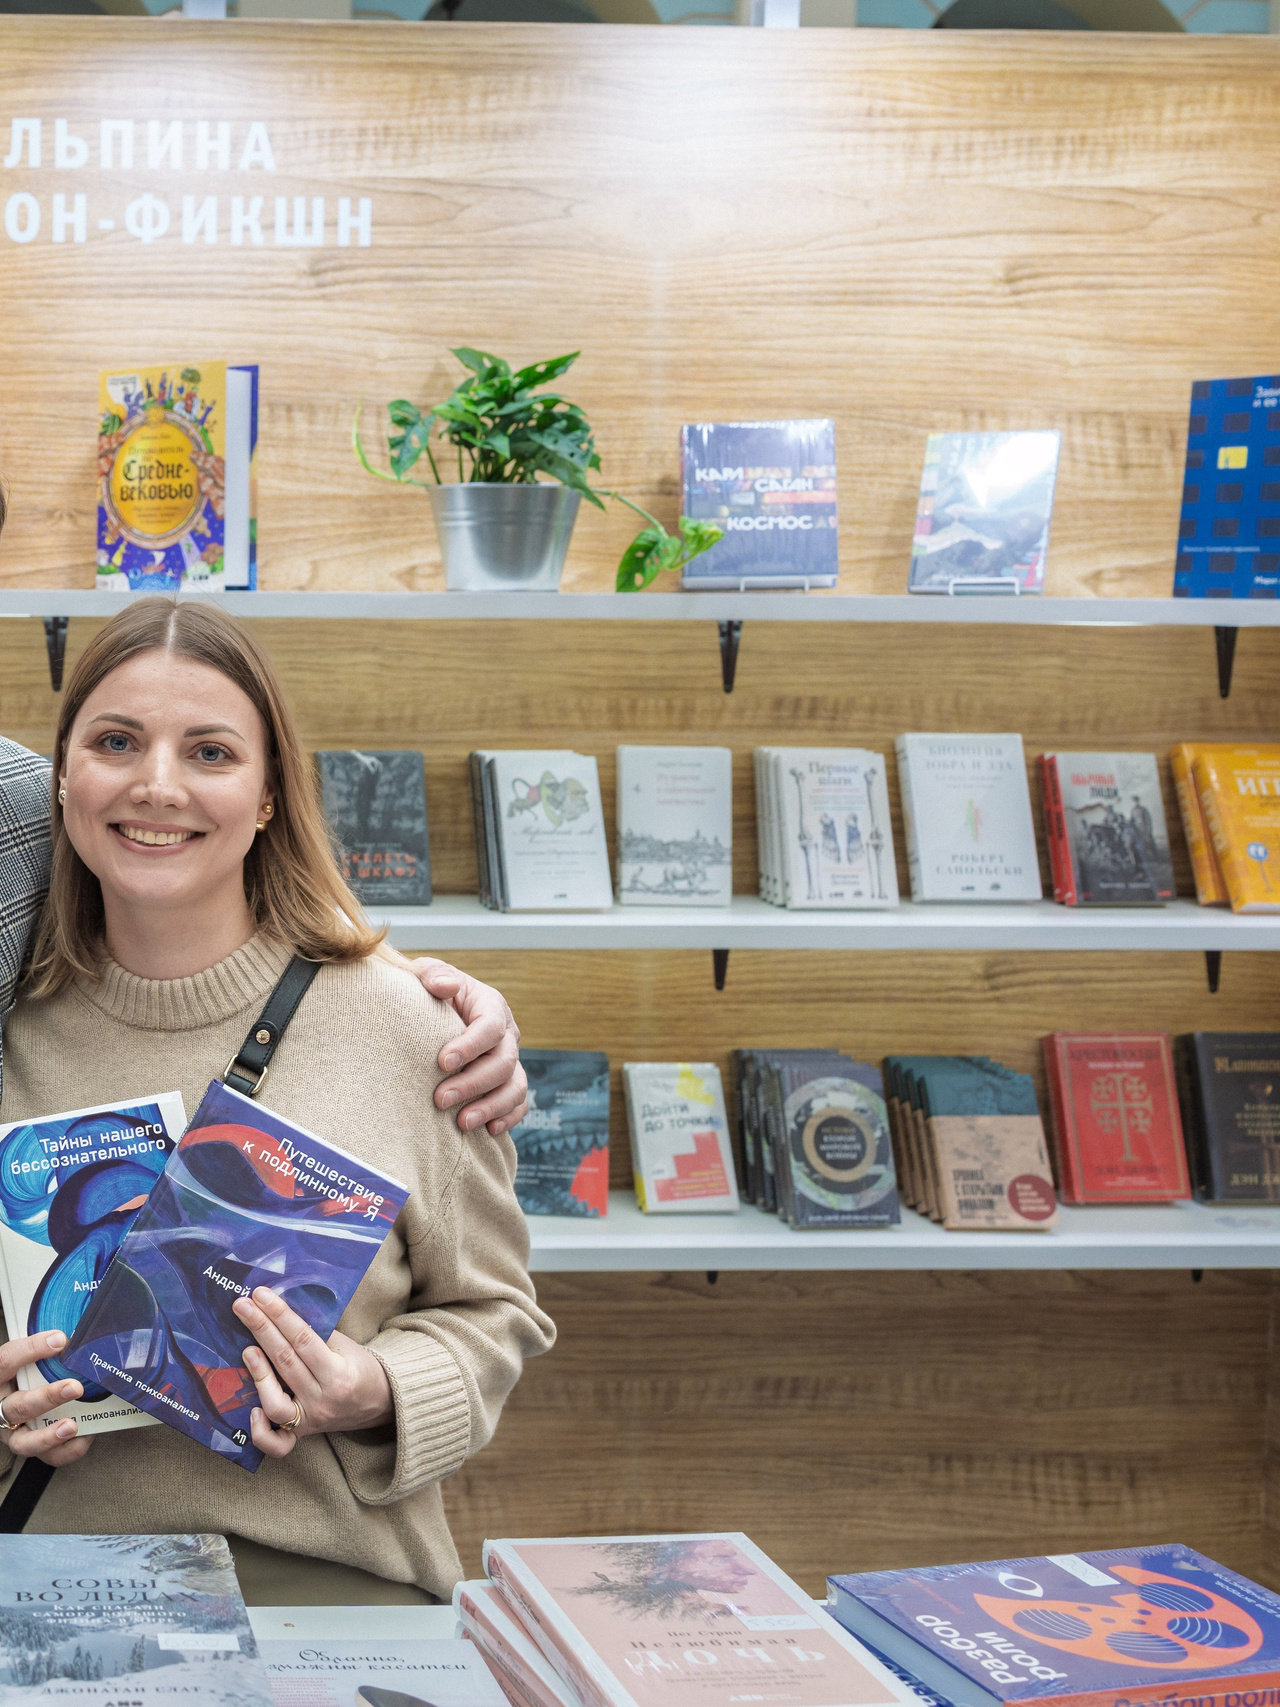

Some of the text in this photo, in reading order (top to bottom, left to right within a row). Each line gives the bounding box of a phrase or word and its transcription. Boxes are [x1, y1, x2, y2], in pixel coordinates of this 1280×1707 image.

[123, 460, 190, 482] Средне-
[120, 484, 194, 501] вековью
[727, 515, 813, 531] КОСМОС
[39, 1123, 163, 1154] Тайны нашего
[11, 1139, 166, 1175] бессознательного
[243, 1141, 380, 1222] к подлинному Я
[277, 1137, 384, 1207] Путешествие
[203, 1266, 251, 1298] Андрей
[89, 1352, 200, 1421] Практика психоанализа
[51, 1579, 157, 1589] СОВЫ
[16, 1591, 200, 1604] ВО ЛЬДАХ
[630, 1638, 798, 1649] Нелюбимая
[915, 1613, 1029, 1684] Разбор
[975, 1631, 1068, 1680] роли
[369, 1663, 472, 1671] косатки
[624, 1646, 826, 1671] ДОЧЬ
[41, 1686, 201, 1694] ДЖОНАТАН СЛАТ
